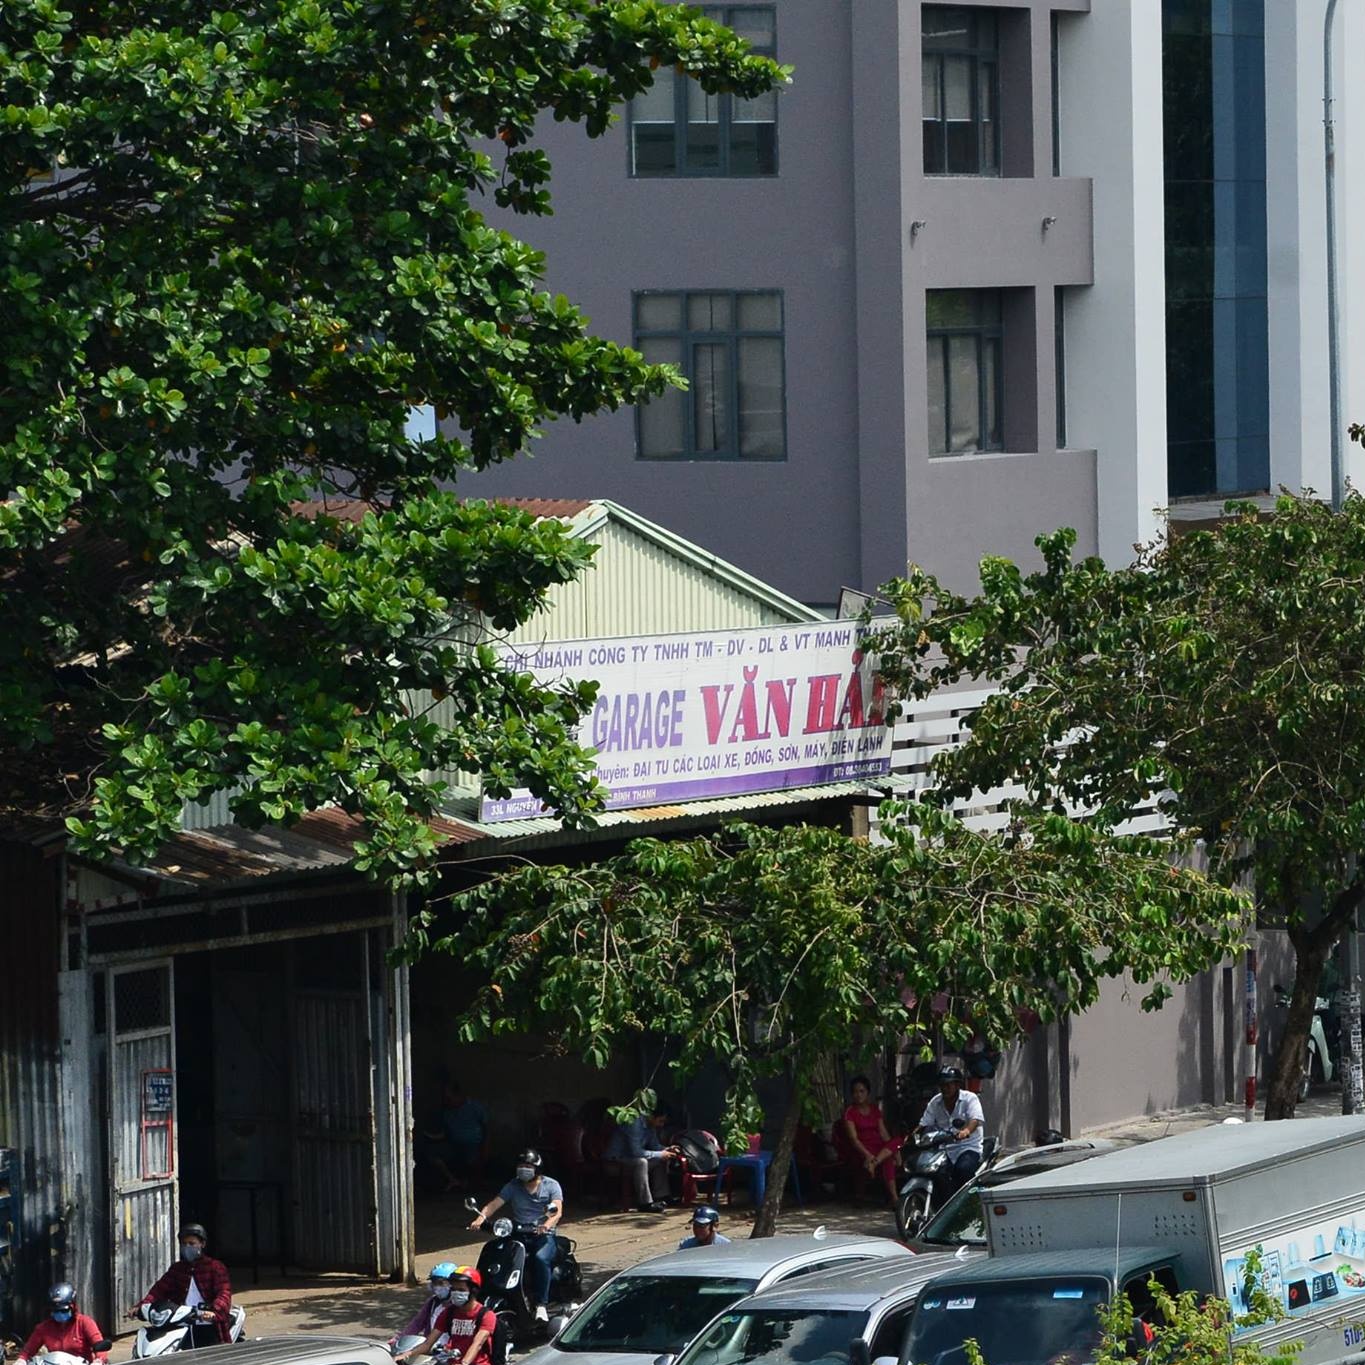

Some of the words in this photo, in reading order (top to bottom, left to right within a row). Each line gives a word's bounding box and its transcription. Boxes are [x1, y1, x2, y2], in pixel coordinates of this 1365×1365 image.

[588, 645, 625, 666] CÔNG
[632, 645, 648, 662] TY
[654, 642, 689, 661] TNHH
[695, 641, 713, 657] TM
[727, 639, 744, 656] DV
[759, 637, 773, 653] DL
[780, 635, 788, 651] &
[795, 634, 811, 649] VT
[592, 689, 686, 751] GARAGE
[700, 664, 797, 746] VĂN
